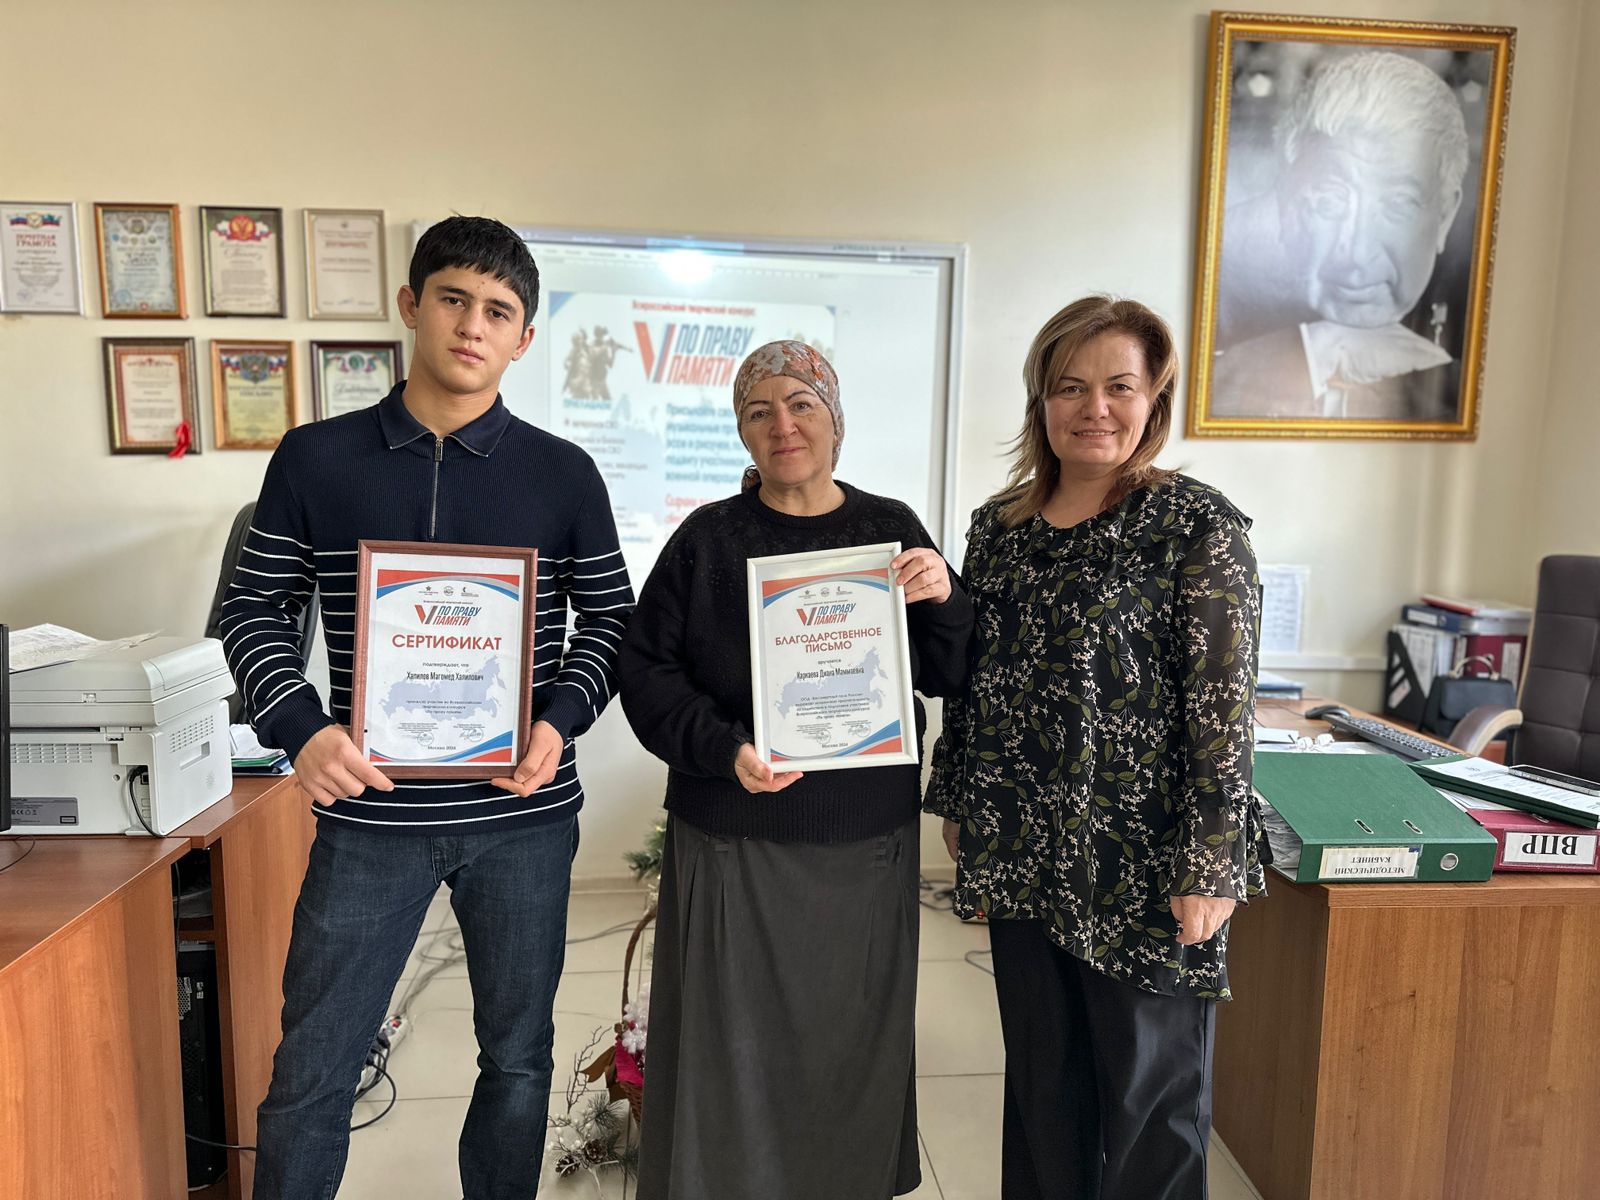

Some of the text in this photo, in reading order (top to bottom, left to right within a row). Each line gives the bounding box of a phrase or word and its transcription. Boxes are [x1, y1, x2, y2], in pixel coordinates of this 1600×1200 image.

[674, 323, 700, 354] ПО
[702, 325, 754, 357] ПРАВУ
[666, 354, 736, 387] ПАМЯТИ
[438, 605, 451, 616] ПО
[451, 606, 482, 617] ПРАВУ
[817, 605, 829, 615] ПО
[829, 602, 856, 614] ПРАВУ
[433, 615, 472, 626] ПАМЯТИ
[814, 613, 848, 626] ПАМЯТИ
[392, 634, 502, 650] СЕРТИФИКАТ
[775, 627, 882, 646] БЛАГОДАРСТВЕННОЕ
[805, 640, 852, 653] ПИСЬМО
[430, 672, 455, 681] Магомед
[1522, 834, 1580, 855] ВПР
